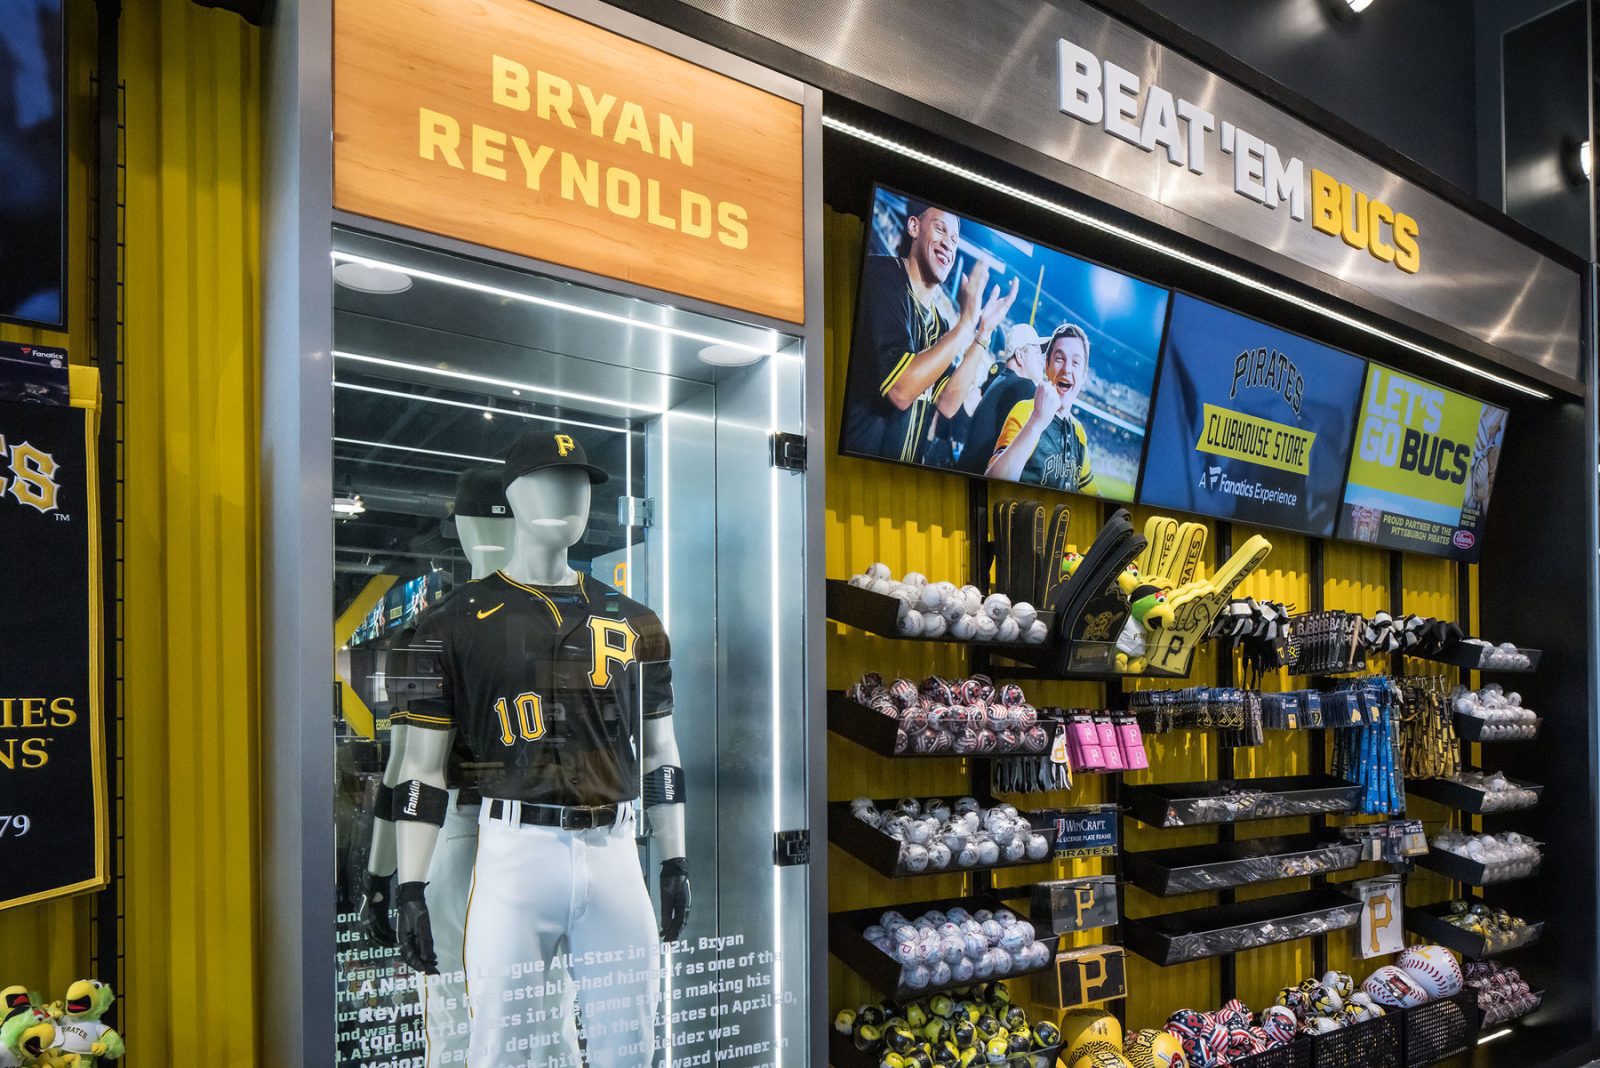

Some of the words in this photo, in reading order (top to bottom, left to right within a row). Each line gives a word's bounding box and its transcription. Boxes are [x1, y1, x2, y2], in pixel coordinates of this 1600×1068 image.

[493, 54, 694, 167] BRYAN
[419, 107, 749, 250] REYNOLDS
[1058, 38, 1215, 175] BEAT
[1221, 121, 1304, 221] 'EM
[1311, 168, 1420, 274] BUCS
[32, 350, 63, 360] Fanatics
[1230, 347, 1304, 415] PIRATES
[1367, 369, 1445, 434] LET'S
[554, 434, 575, 456] P
[1207, 413, 1273, 458] CLUBHOUSE
[1273, 430, 1307, 466] STORE
[1359, 415, 1402, 467] GO
[1400, 427, 1470, 485] BUCS
[0, 434, 60, 514] S
[1199, 472, 1207, 488] A
[1219, 473, 1254, 498] Fanatics
[1254, 483, 1297, 506] Experience
[1383, 515, 1404, 526] PROUD
[1405, 518, 1431, 532] PARTNER
[1432, 525, 1440, 534] OF
[1441, 527, 1452, 536] THE
[1391, 526, 1427, 541] PITTSBURGH
[1427, 534, 1450, 545] PIRATES
[1214, 556, 1261, 606] PIRATES
[586, 615, 640, 689] P
[1162, 634, 1185, 668] P
[494, 691, 546, 746] 10
[1074, 886, 1095, 927] P
[1368, 892, 1393, 953] P
[360, 980, 375, 996] A
[550, 950, 624, 970] All-Star
[628, 945, 646, 960] in
[699, 934, 744, 951] Bryan
[686, 961, 704, 975] as
[708, 958, 735, 972] one
[739, 952, 755, 967] of
[757, 950, 782, 965] the
[1077, 953, 1108, 1004] P
[360, 1032, 396, 1051] top
[526, 1007, 546, 1023] in
[585, 995, 631, 1018] game
[686, 978, 743, 998] making
[747, 972, 771, 988] his
[506, 1031, 560, 1053] debut
[611, 1018, 639, 1034] the
[711, 1003, 729, 1017] on
[732, 994, 771, 1015] April
[618, 1030, 705, 1057] outielder
[709, 1024, 740, 1040] was
[715, 1040, 771, 1061] winner
